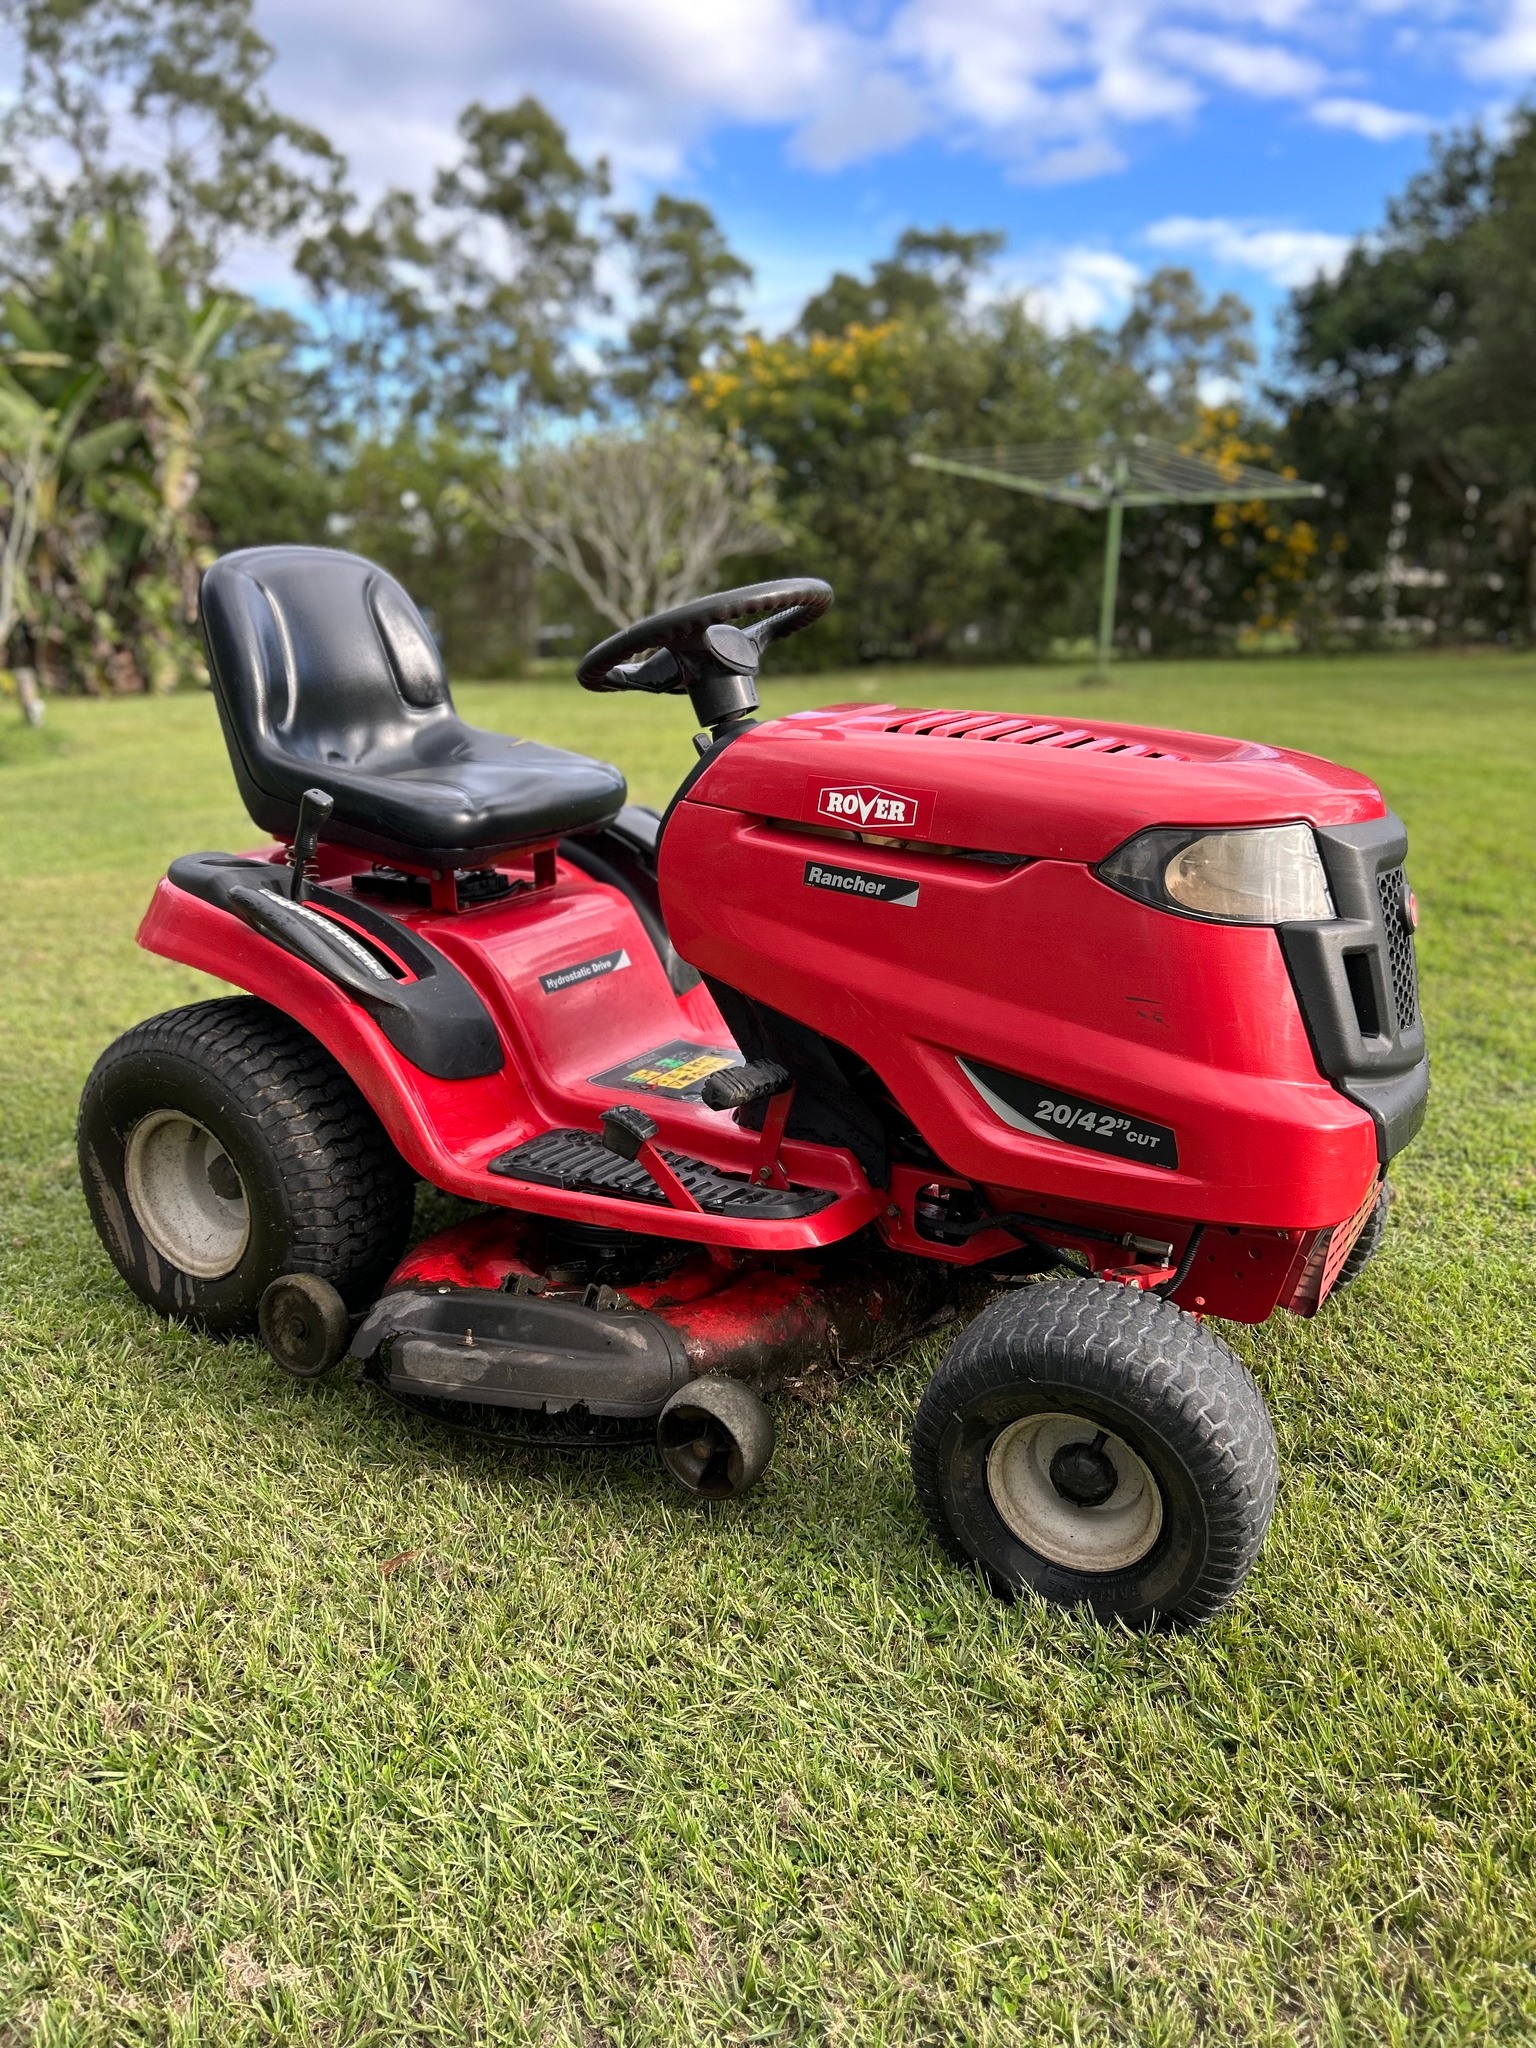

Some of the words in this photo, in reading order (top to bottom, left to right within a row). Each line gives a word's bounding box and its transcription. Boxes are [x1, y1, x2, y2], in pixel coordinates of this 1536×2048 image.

[826, 789, 906, 825] ROVER
[808, 866, 886, 896] Rancher
[546, 966, 592, 989] Hydrostatic
[591, 960, 612, 973] Drive
[1126, 1130, 1161, 1148] CUT
